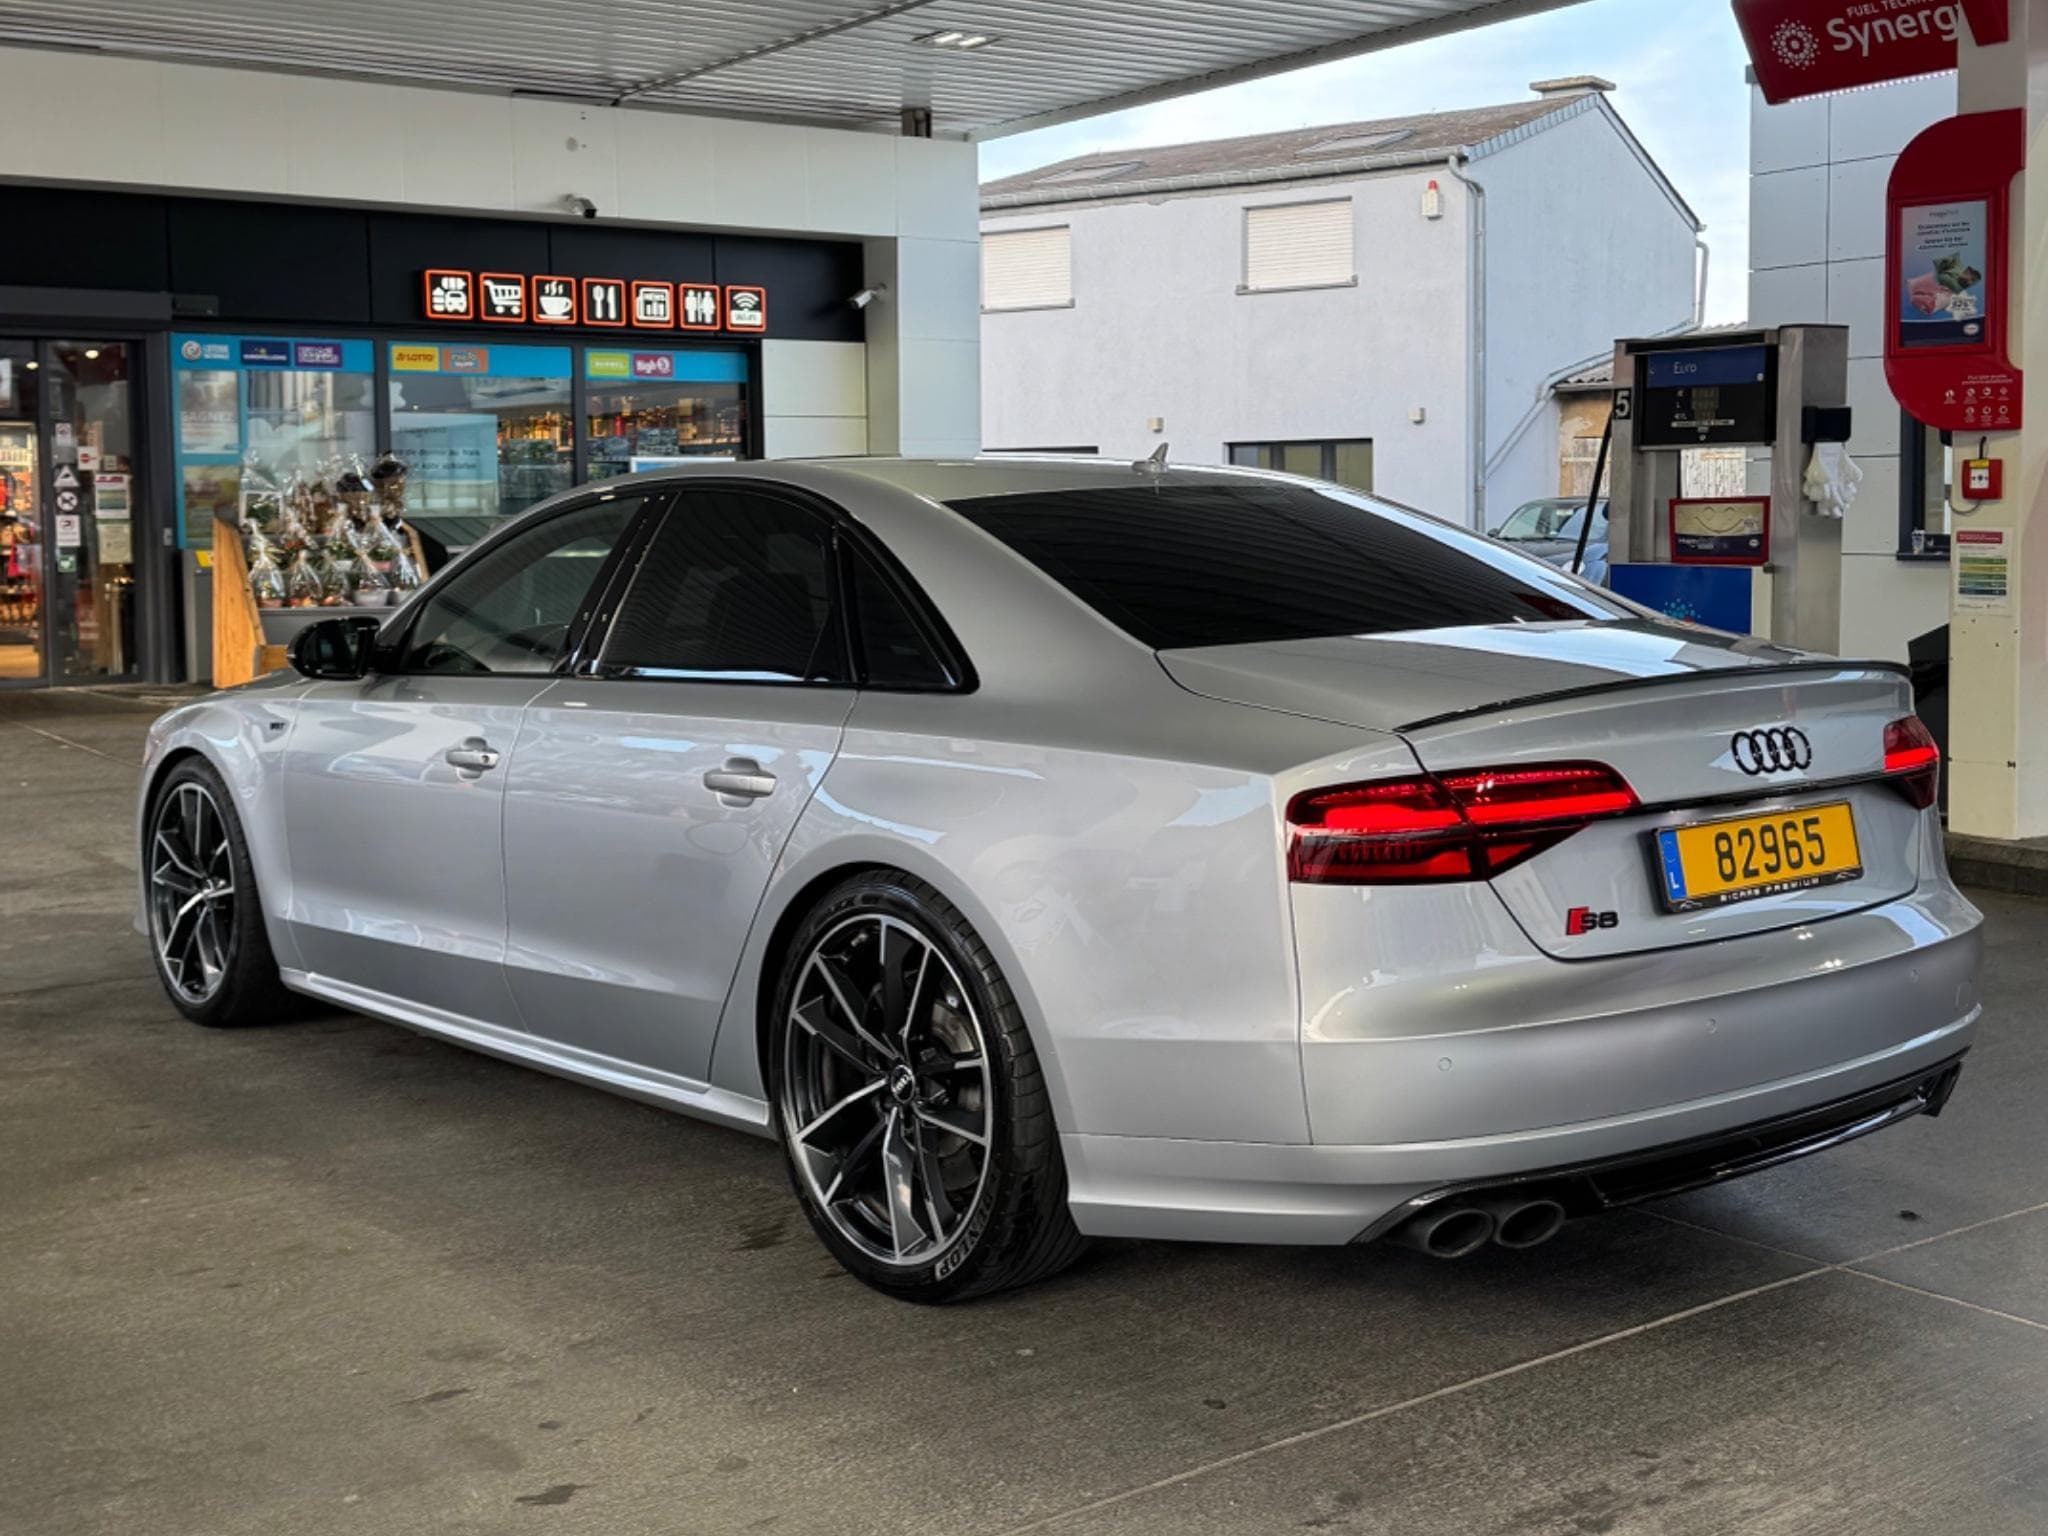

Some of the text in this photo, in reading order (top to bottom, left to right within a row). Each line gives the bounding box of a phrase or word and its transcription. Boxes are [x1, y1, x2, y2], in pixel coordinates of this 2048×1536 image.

[1846, 3, 1880, 18] FUEL
[1825, 4, 1959, 57] Synerg
[1615, 390, 1630, 417] 5
[1669, 816, 1826, 890] L 82965
[1765, 877, 1820, 895] PREMIUM
[1580, 910, 1620, 931] S8
